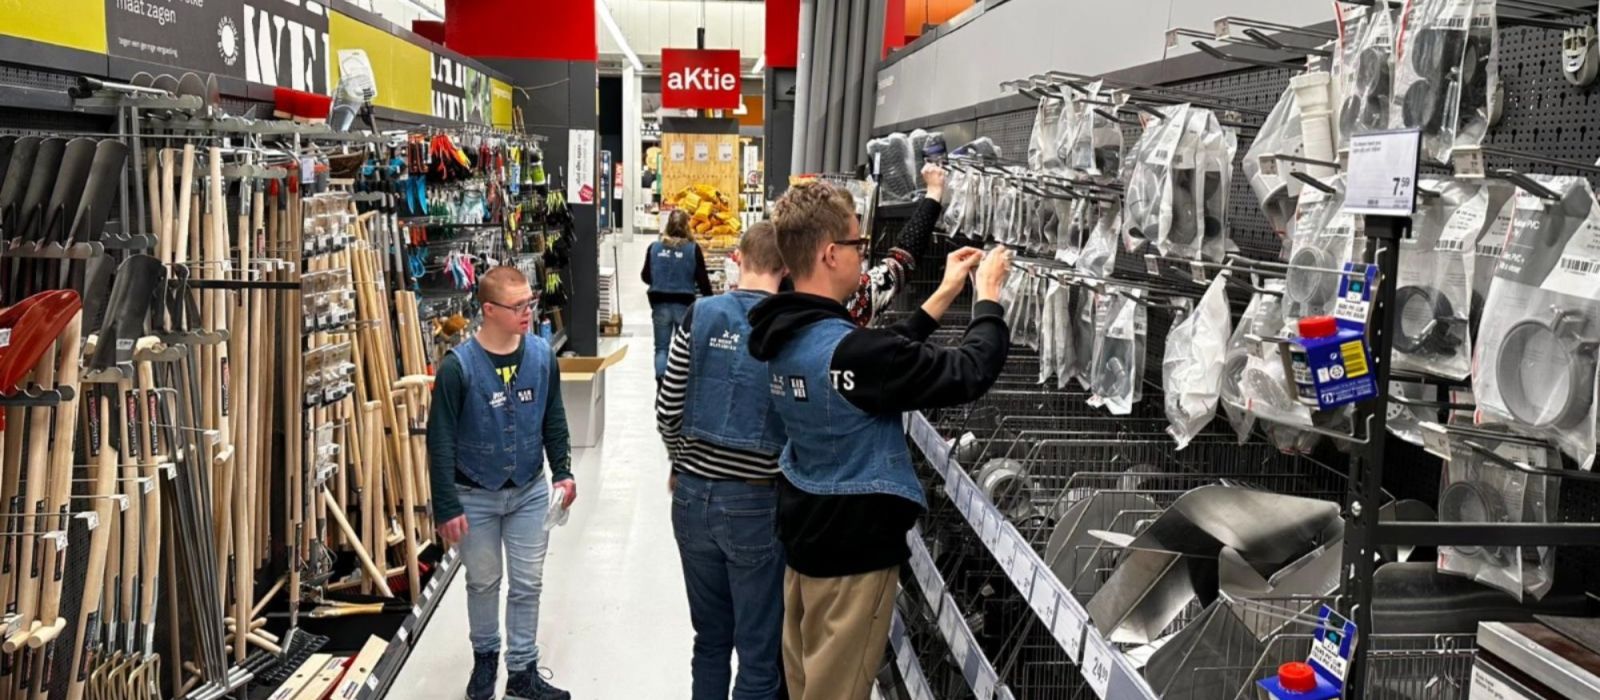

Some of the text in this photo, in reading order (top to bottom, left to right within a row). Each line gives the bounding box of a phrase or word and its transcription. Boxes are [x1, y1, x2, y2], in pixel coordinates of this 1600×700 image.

[116, 0, 145, 15] maat
[147, 3, 176, 25] zagen
[667, 66, 736, 91] aKtie
[830, 370, 855, 391] TS
